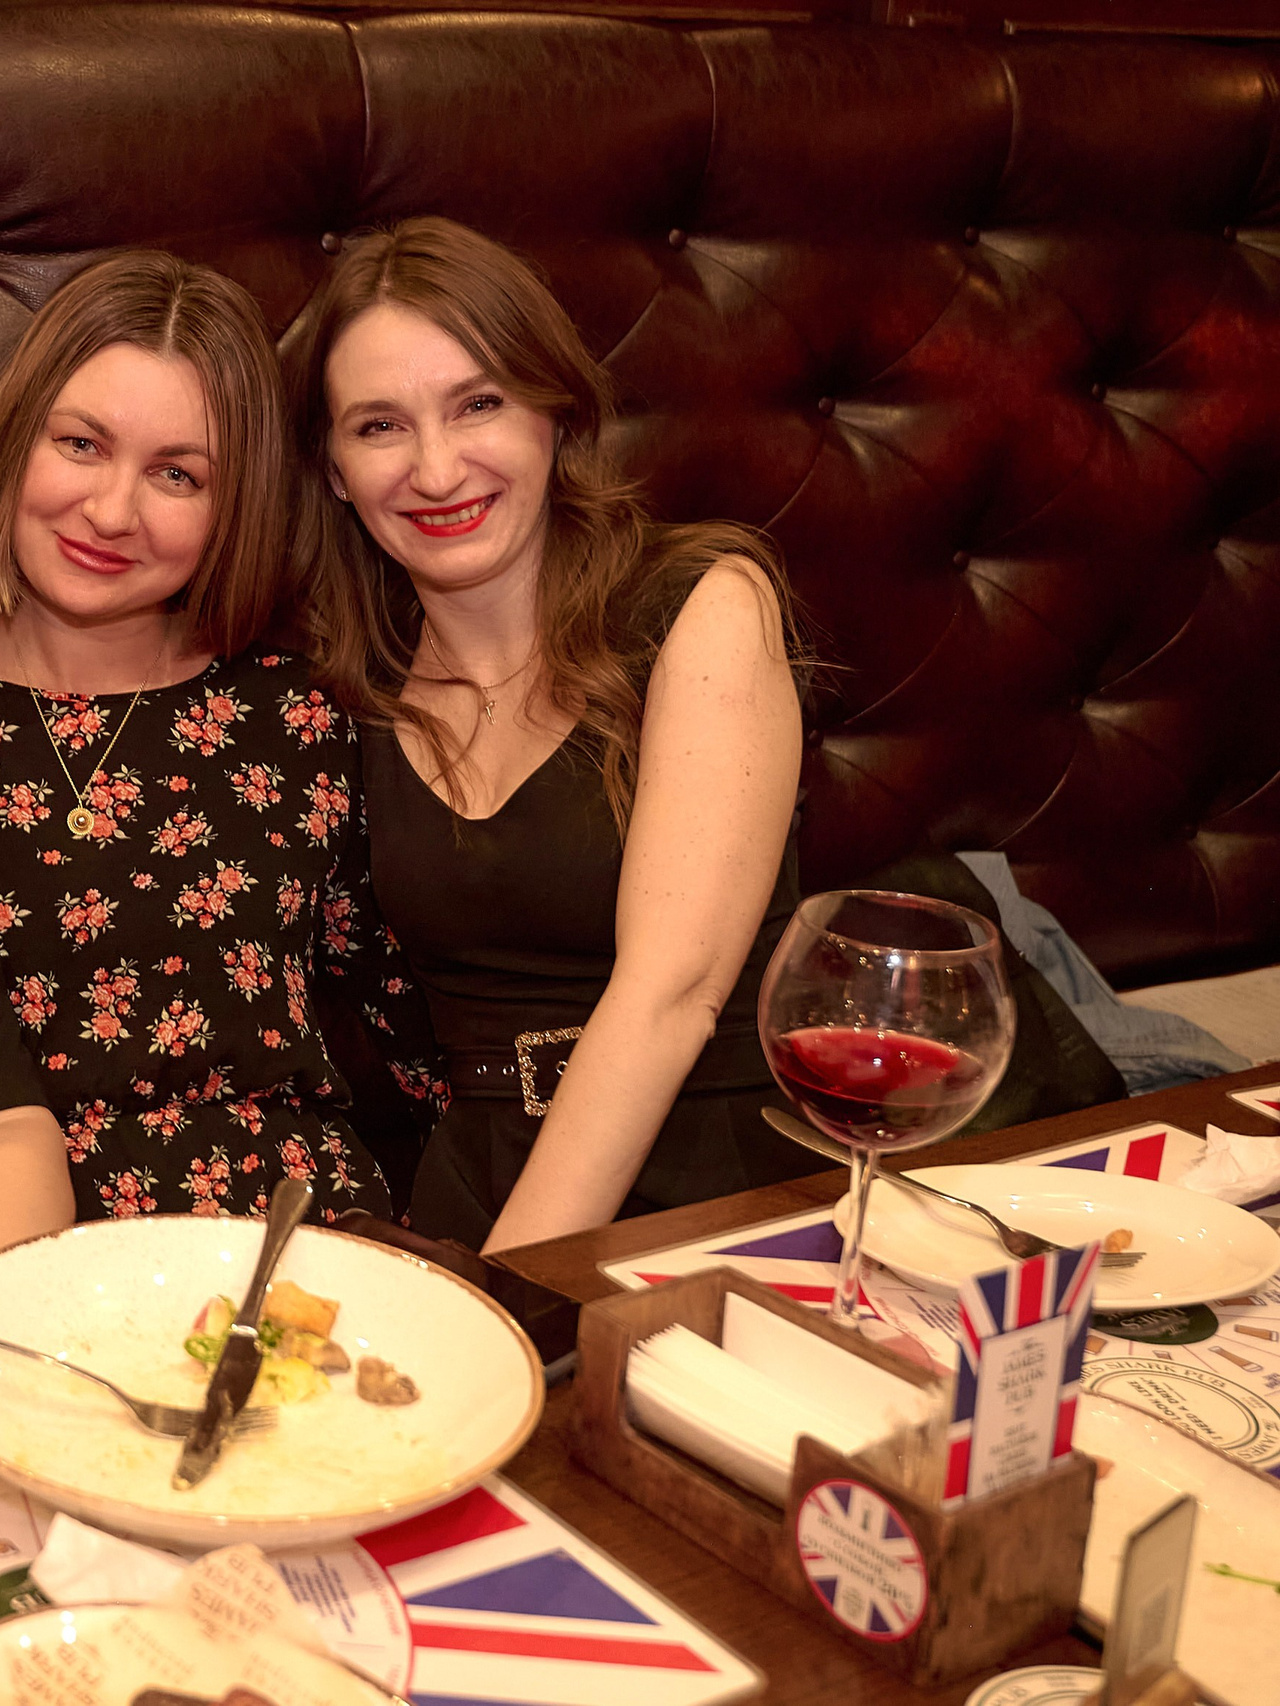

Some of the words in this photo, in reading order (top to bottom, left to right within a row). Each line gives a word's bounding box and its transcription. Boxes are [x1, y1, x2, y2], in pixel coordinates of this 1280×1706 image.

[1105, 1360, 1176, 1373] SHARK
[1185, 1368, 1227, 1388] PUB
[1127, 1381, 1152, 1396] LIKE
[1186, 1413, 1215, 1434] NEED
[1235, 1432, 1280, 1459] JAMES
